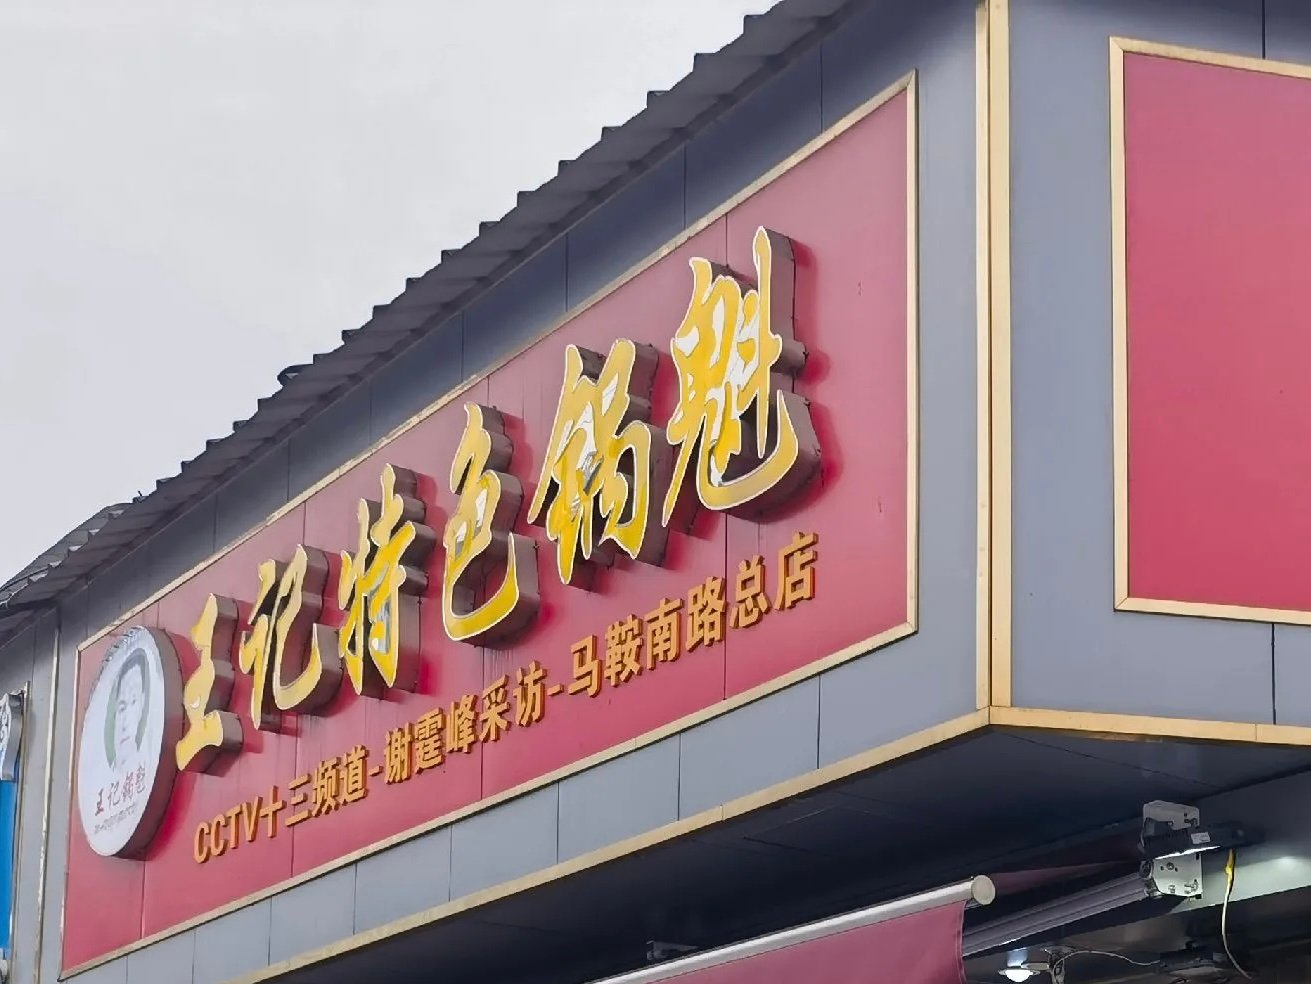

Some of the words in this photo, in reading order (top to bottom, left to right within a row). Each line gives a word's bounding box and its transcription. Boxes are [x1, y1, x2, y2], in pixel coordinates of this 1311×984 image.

[173, 226, 812, 772] 王记特色锅魁
[193, 531, 820, 864] CCTV十三频道-谢霆峰采访-马鞍南路总店
